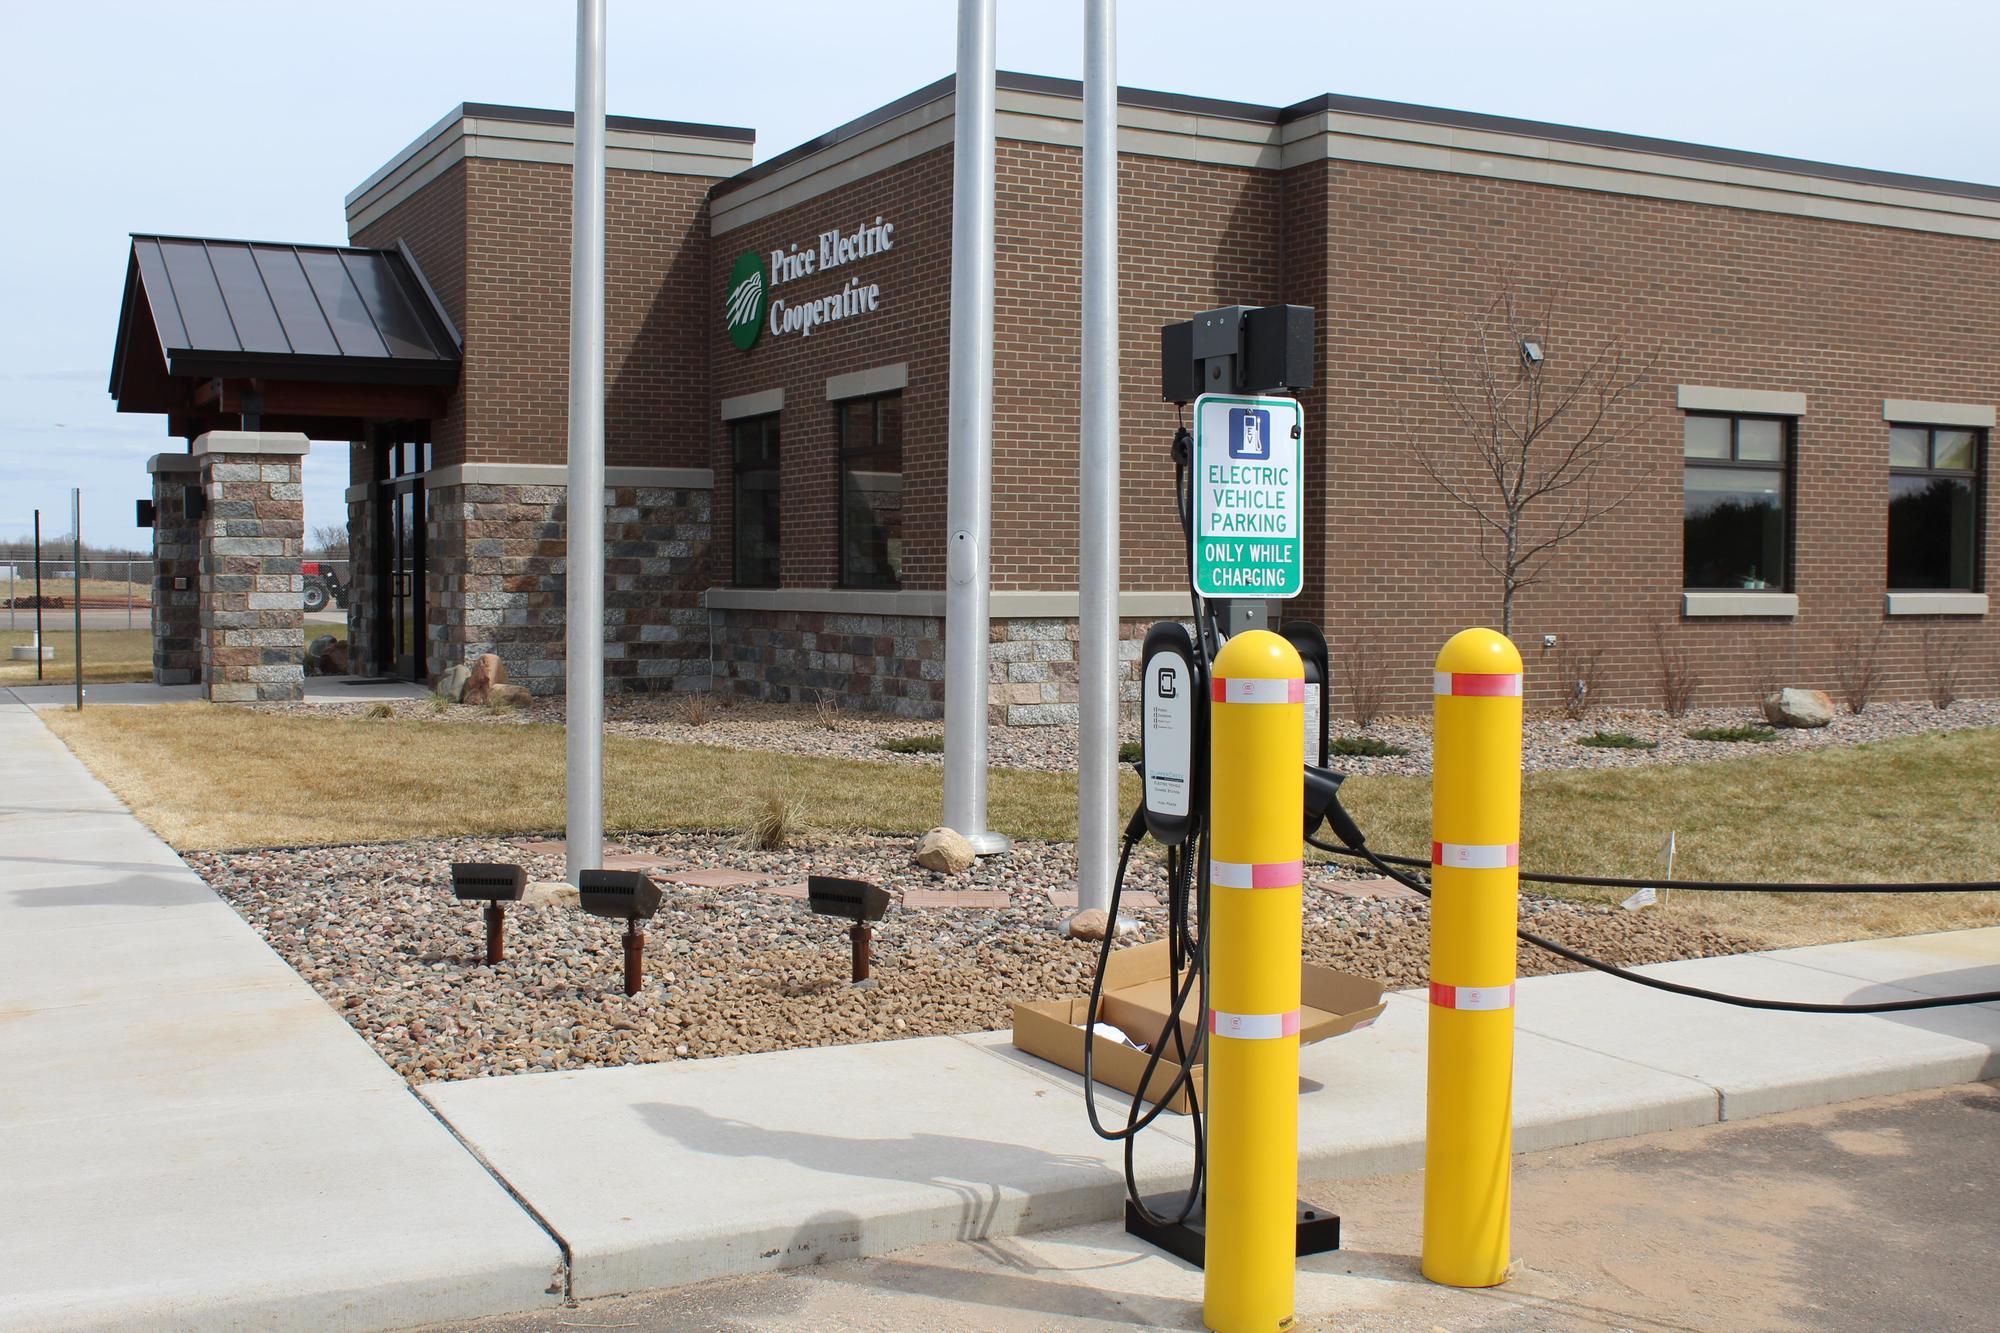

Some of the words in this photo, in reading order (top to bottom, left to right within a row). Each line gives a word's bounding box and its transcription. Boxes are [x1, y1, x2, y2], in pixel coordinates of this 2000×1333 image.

[770, 243, 816, 286] Price
[818, 215, 894, 271] Electric
[770, 277, 880, 337] Cooperative
[1208, 465, 1289, 486] ELECTRIC
[1213, 489, 1286, 510] VEHICLE
[1211, 512, 1287, 533] PARKING
[1205, 543, 1244, 563] ONLY
[1249, 544, 1293, 563] WHILE
[1212, 568, 1286, 587] CHARGING
